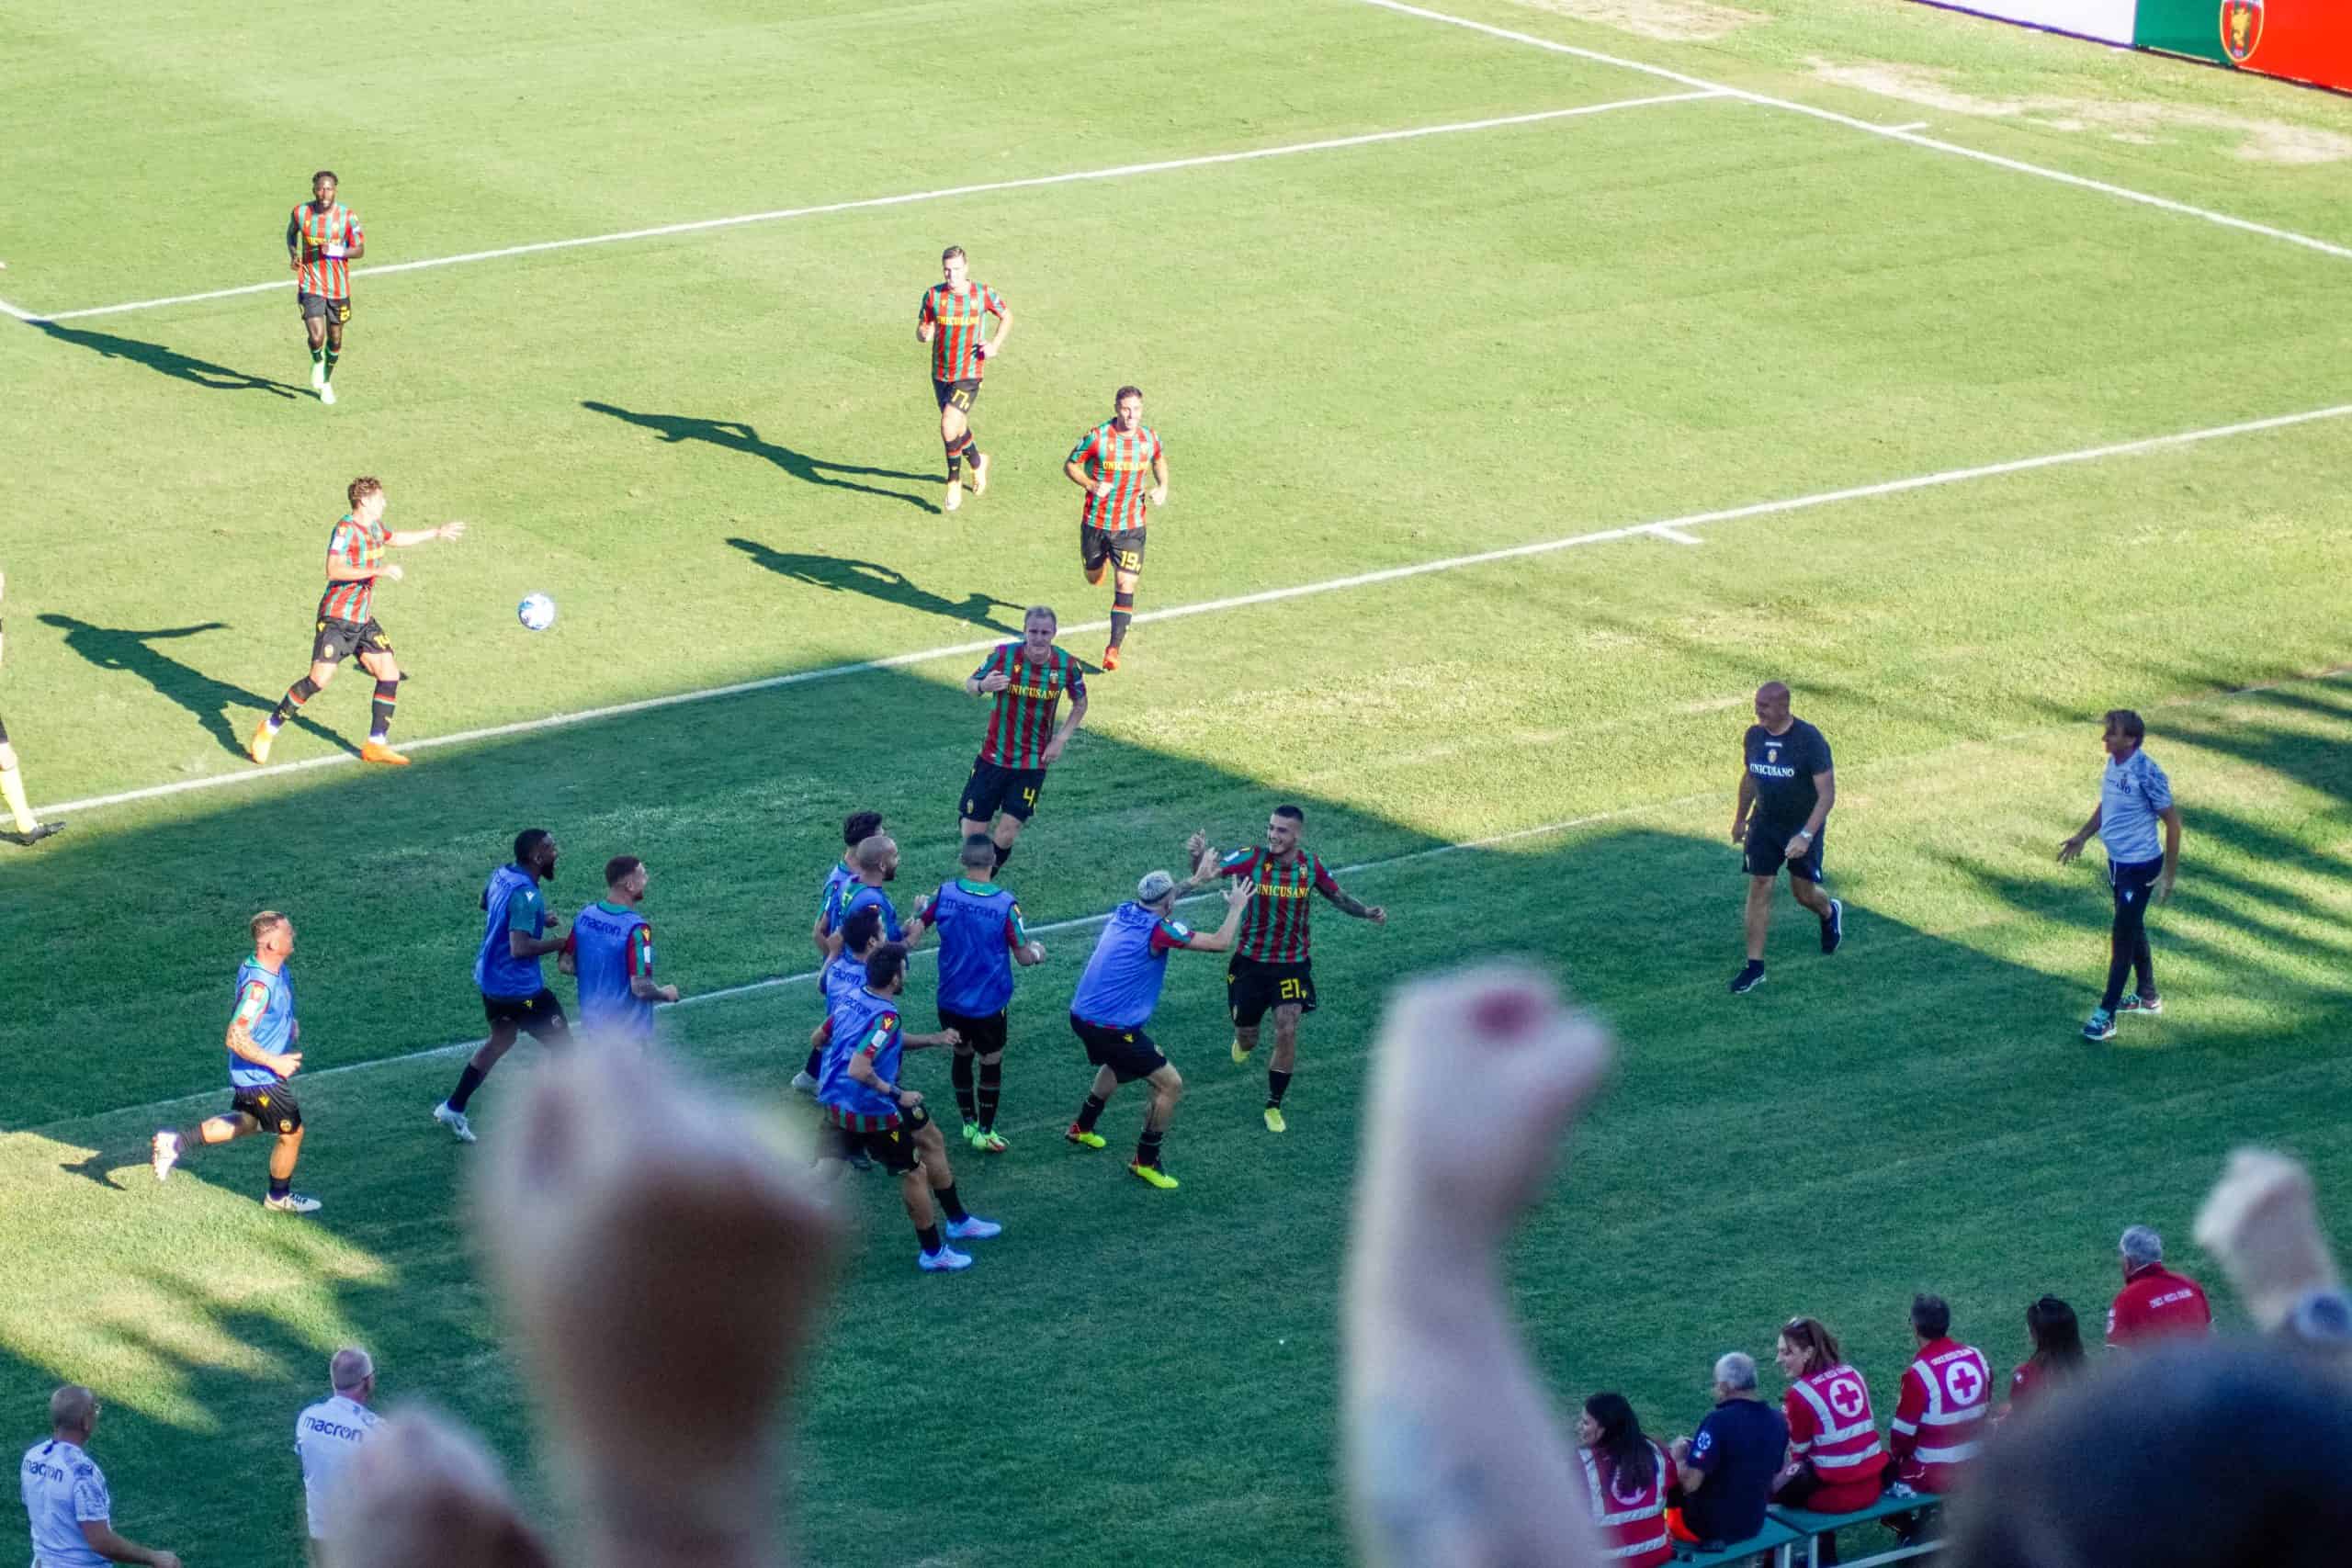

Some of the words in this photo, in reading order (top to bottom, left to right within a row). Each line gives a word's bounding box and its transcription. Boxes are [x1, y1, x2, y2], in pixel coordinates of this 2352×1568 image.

[1023, 786, 1035, 807] 4
[580, 915, 622, 935] macron
[1279, 977, 1300, 999] 21
[302, 1416, 364, 1443] macron
